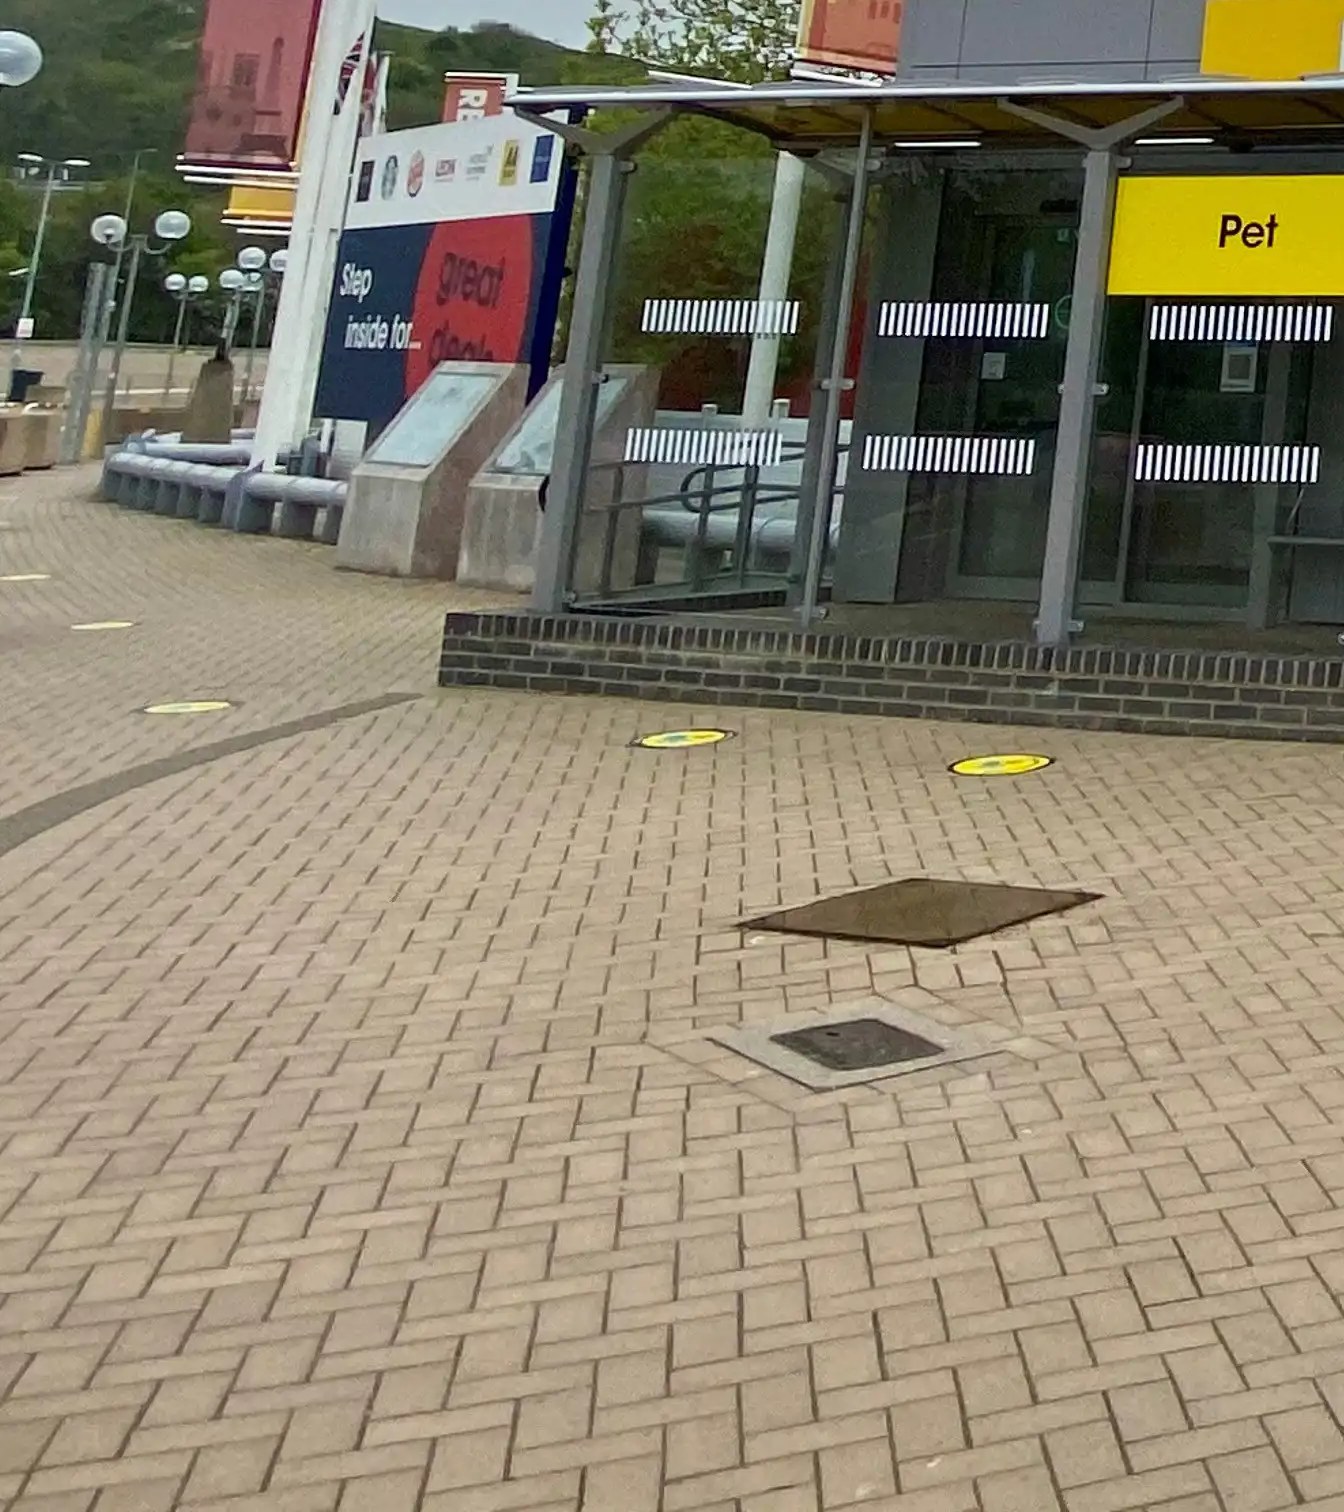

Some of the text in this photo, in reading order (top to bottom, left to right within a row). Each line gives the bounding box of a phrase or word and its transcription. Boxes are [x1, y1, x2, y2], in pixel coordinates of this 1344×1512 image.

[1218, 213, 1279, 249] Pet
[339, 262, 373, 303] Step
[344, 315, 388, 349] inside
